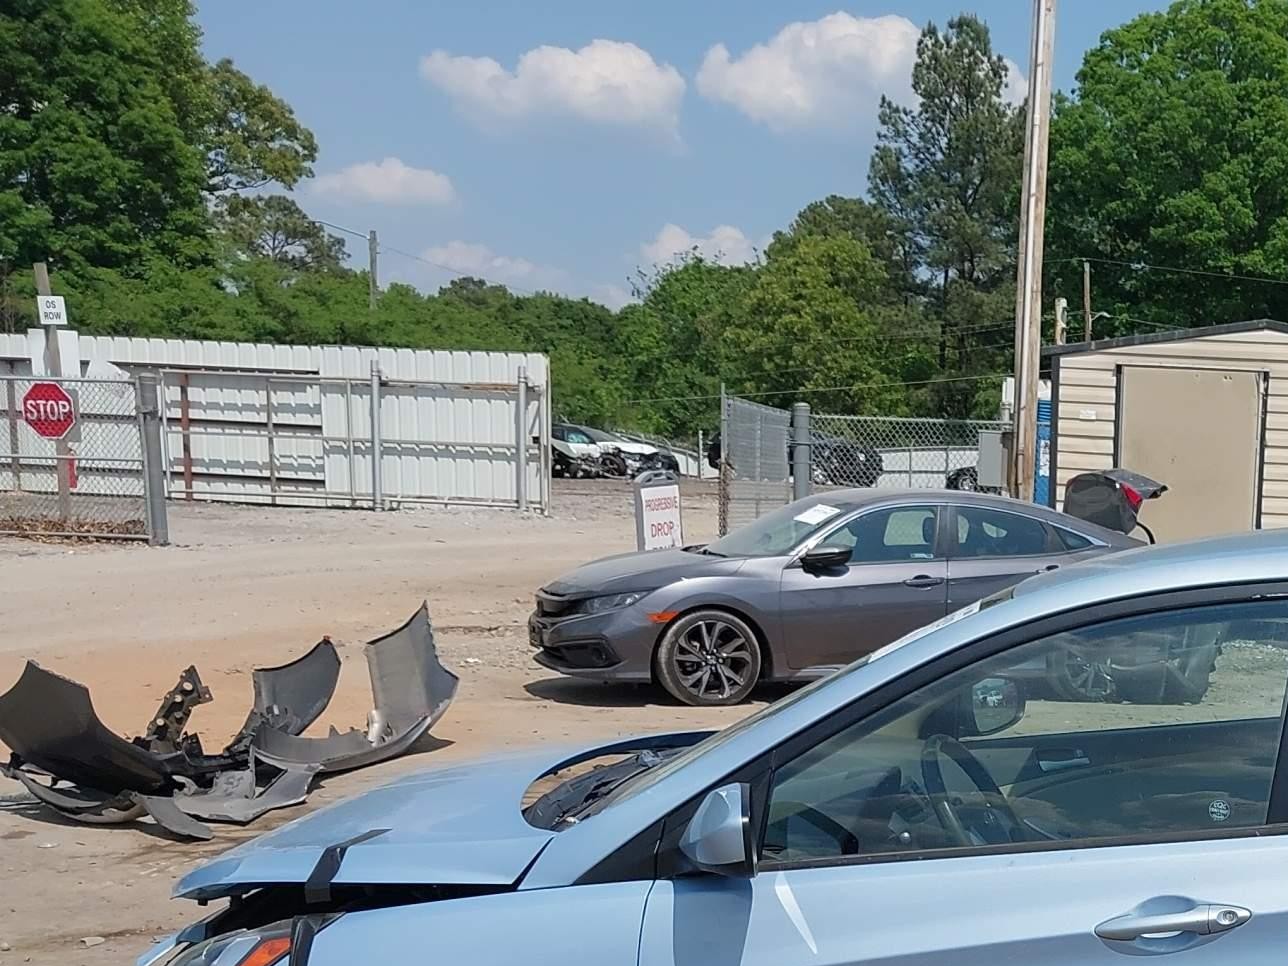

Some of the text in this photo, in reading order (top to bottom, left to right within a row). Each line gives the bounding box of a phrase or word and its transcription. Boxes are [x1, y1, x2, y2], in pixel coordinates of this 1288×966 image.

[43, 311, 62, 320] ROW
[26, 399, 70, 421] STOP
[651, 521, 674, 538] DROP
